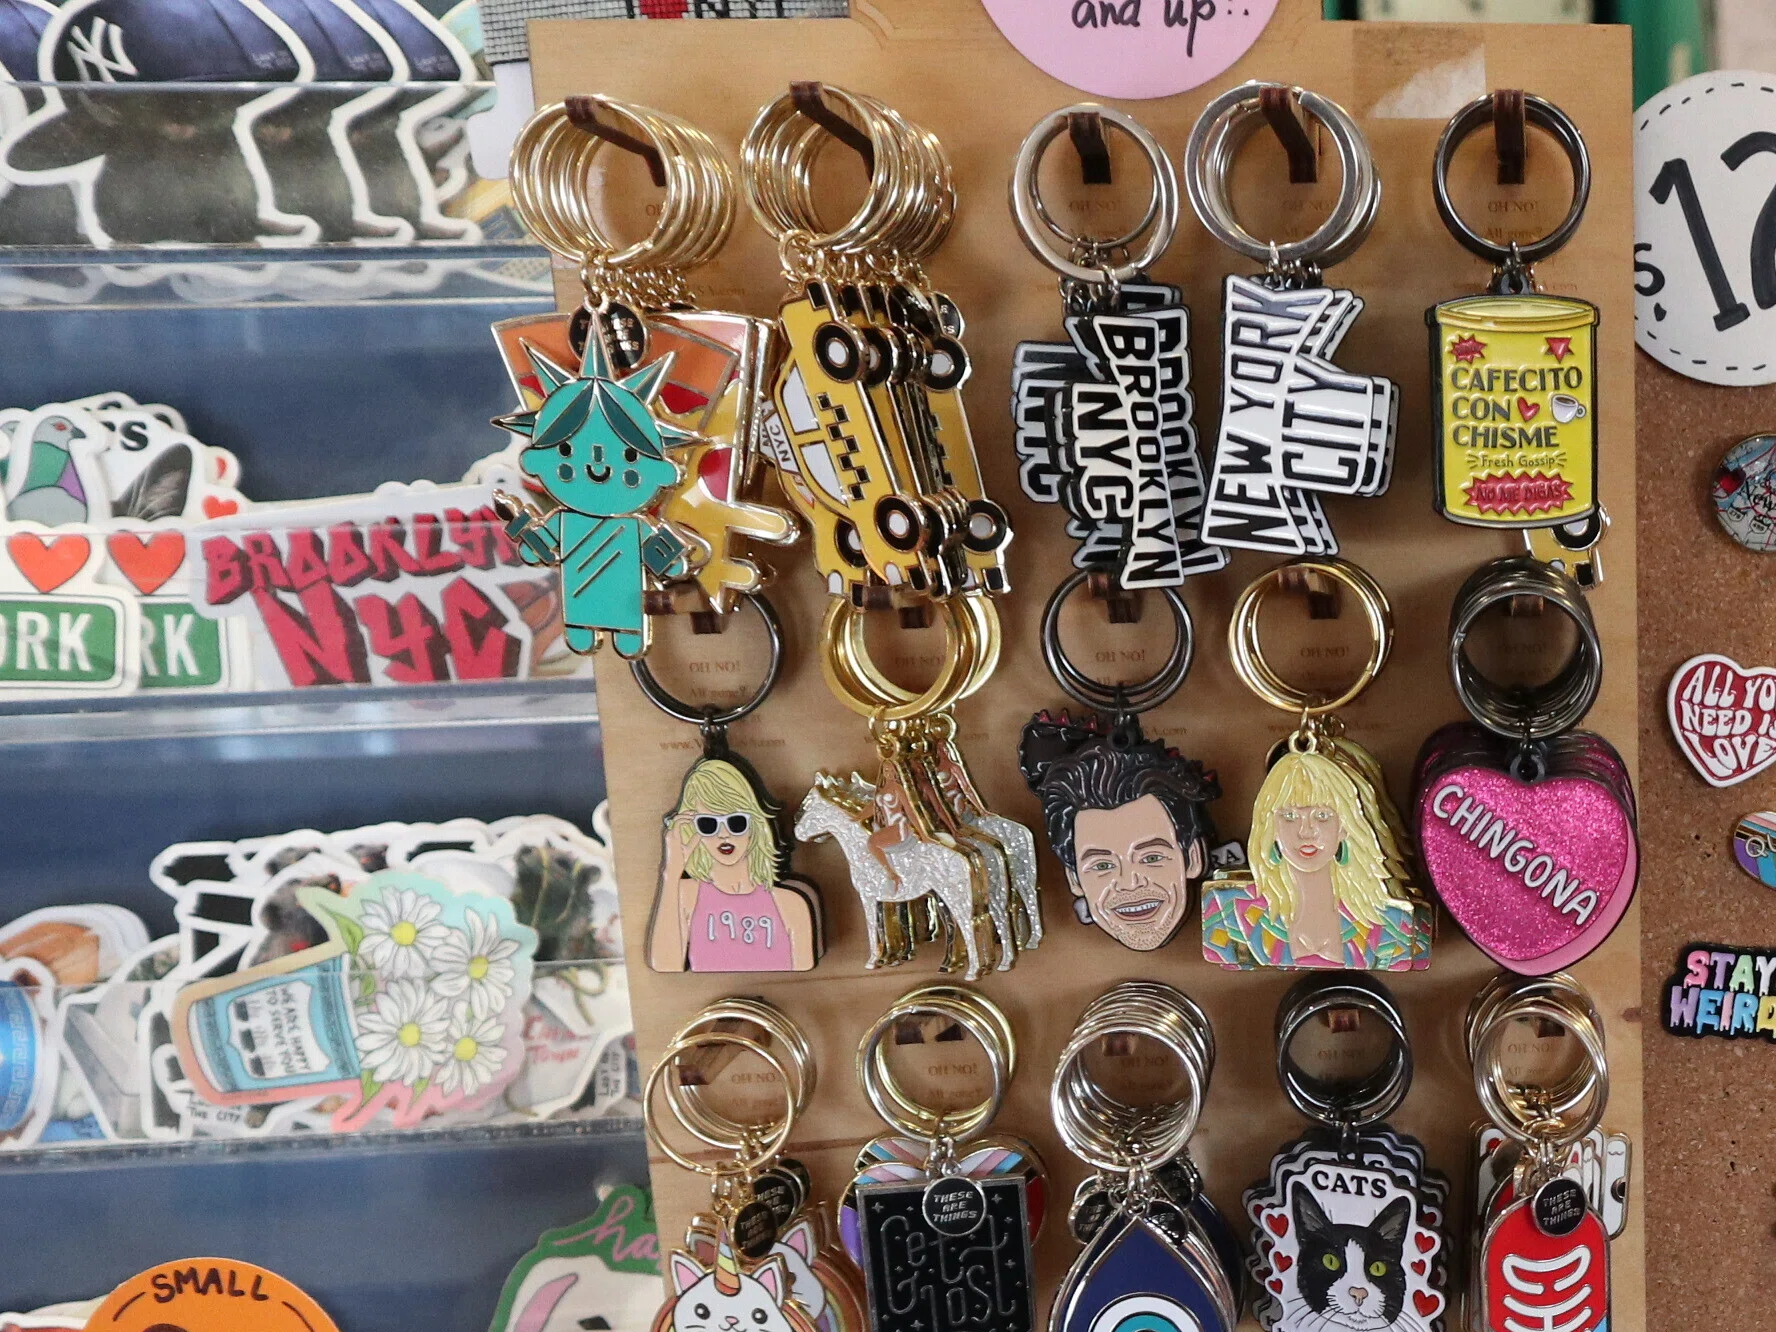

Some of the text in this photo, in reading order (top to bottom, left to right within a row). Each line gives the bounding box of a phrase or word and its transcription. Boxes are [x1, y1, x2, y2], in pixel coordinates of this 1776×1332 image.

[1450, 366, 1584, 393] CAFECITO
[1208, 282, 1334, 545] NEW YORK
[1282, 354, 1374, 490] CITY
[1451, 396, 1511, 422] CON
[1097, 322, 1181, 583] BROOKLYN
[1452, 425, 1561, 449] CHISME
[1076, 390, 1135, 519] NYC
[1481, 455, 1556, 469] Fresh Gossip
[257, 577, 520, 686] NYC
[689, 661, 710, 674] OH
[1682, 664, 1738, 708] ALL
[1680, 700, 1753, 738] NEED
[1432, 783, 1601, 927] CHINGONA
[706, 911, 775, 950] 1989
[932, 1190, 975, 1205] THESE
[1310, 1169, 1388, 1200] CATS
[1542, 1190, 1577, 1206] THESE
[932, 1210, 978, 1223] THINGS
[943, 1201, 969, 1212] ARE
[1542, 1208, 1582, 1226] THINGS
[151, 1265, 270, 1304] SMALL
